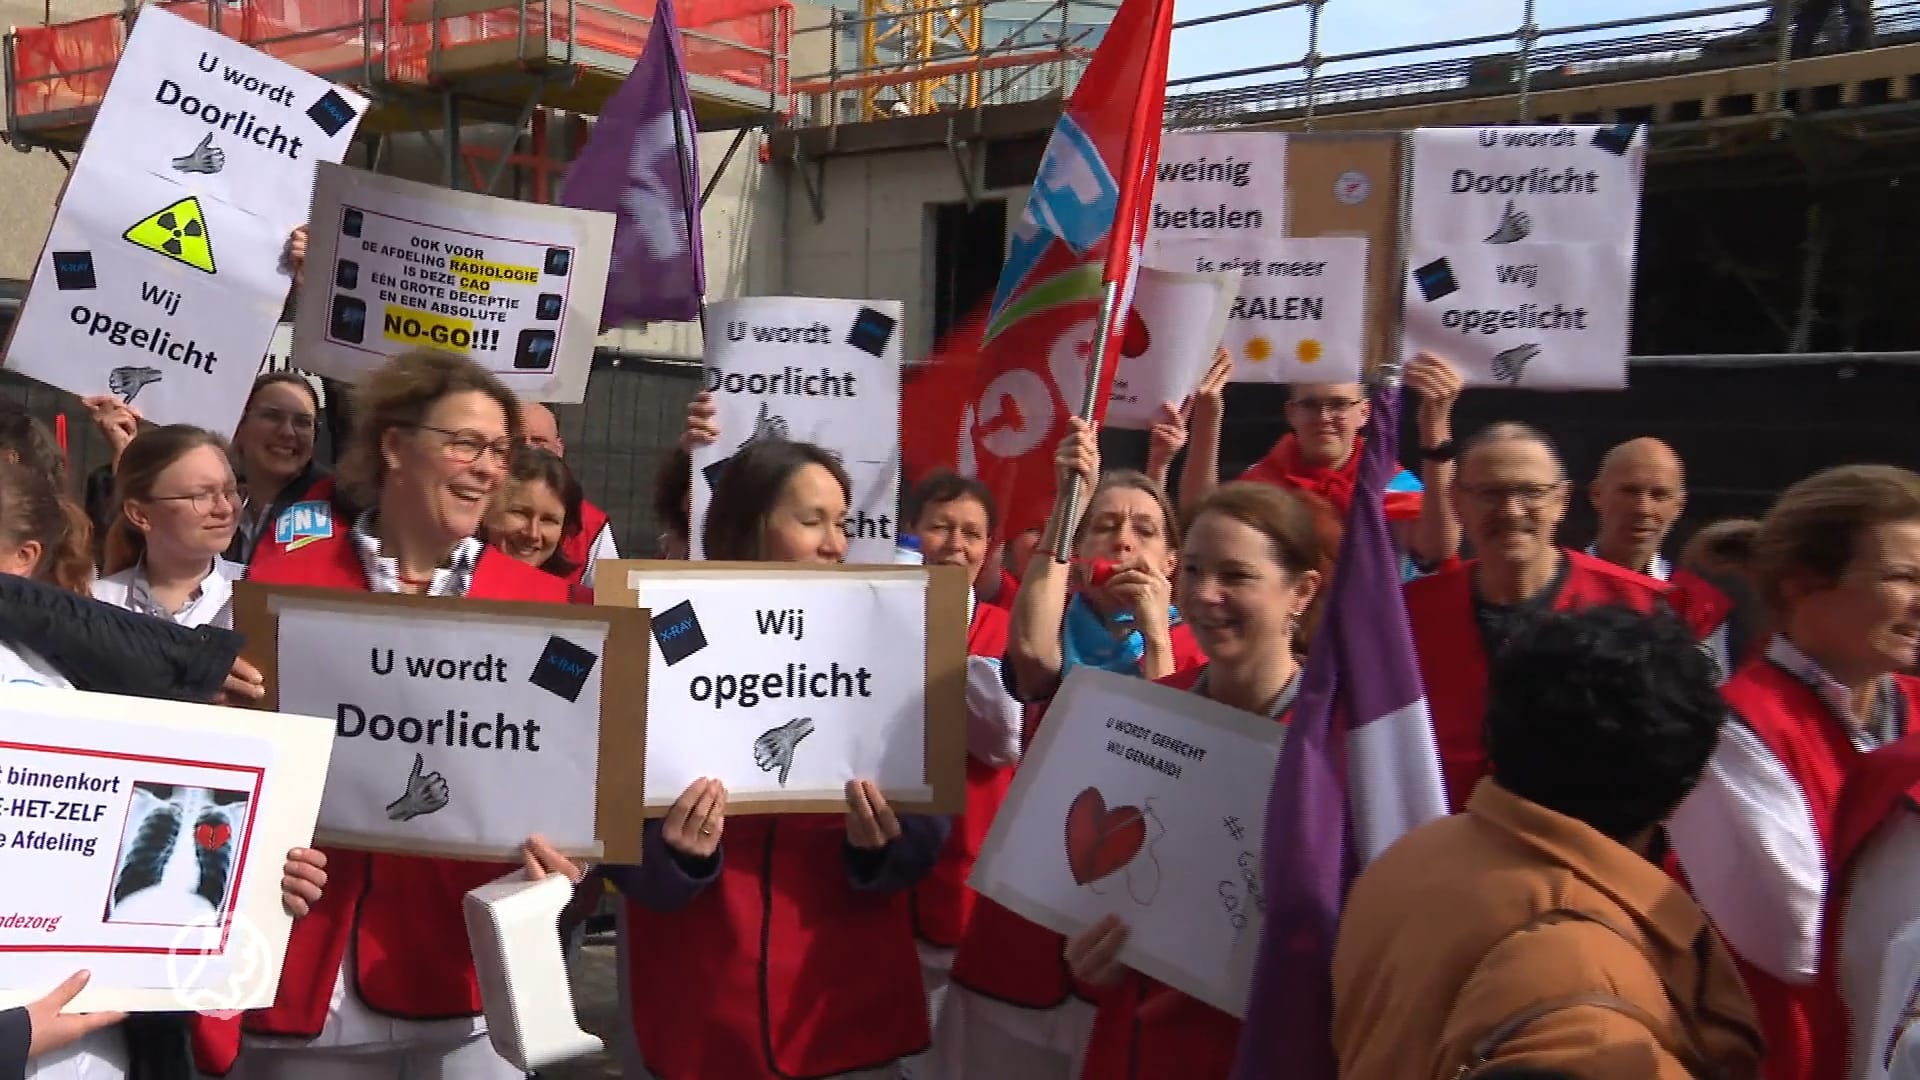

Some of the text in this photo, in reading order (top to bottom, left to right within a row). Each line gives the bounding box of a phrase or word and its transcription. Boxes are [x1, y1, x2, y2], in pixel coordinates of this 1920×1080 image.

[199, 52, 296, 107] U wordt
[155, 79, 303, 160] Doorlicht
[1479, 128, 1577, 147] U wordt
[1155, 156, 1253, 187] weinig
[1451, 167, 1601, 195] Doorlicht
[1151, 204, 1264, 230] betalen
[362, 240, 539, 283] DE AFDELING RADIOLOGIE
[411, 236, 484, 260] OOK VOOR
[404, 266, 490, 291] IS DEZE CAO
[1267, 261, 1328, 277] meer
[141, 281, 182, 316] Wij
[379, 290, 507, 322] EN EEN ABSOLUTE
[400, 281, 444, 299] GROTE
[449, 289, 520, 309] DECEPTIE
[1228, 296, 1324, 320] RALEN
[384, 314, 499, 350] NO-GO!!!
[727, 321, 833, 344] U wordt
[1441, 303, 1589, 335] opgelicht
[70, 304, 218, 374] opgelicht
[280, 506, 331, 536] FNV
[660, 617, 694, 642] X-RAY
[755, 609, 805, 640] Wij
[371, 648, 508, 683] U wordt
[547, 654, 584, 677] X-RAY
[690, 662, 872, 709] opgelicht
[336, 703, 541, 752] Doorlicht
[1114, 719, 1152, 741] WORDT
[7, 766, 120, 793] binnenkort
[11, 830, 98, 857] Afdeling
